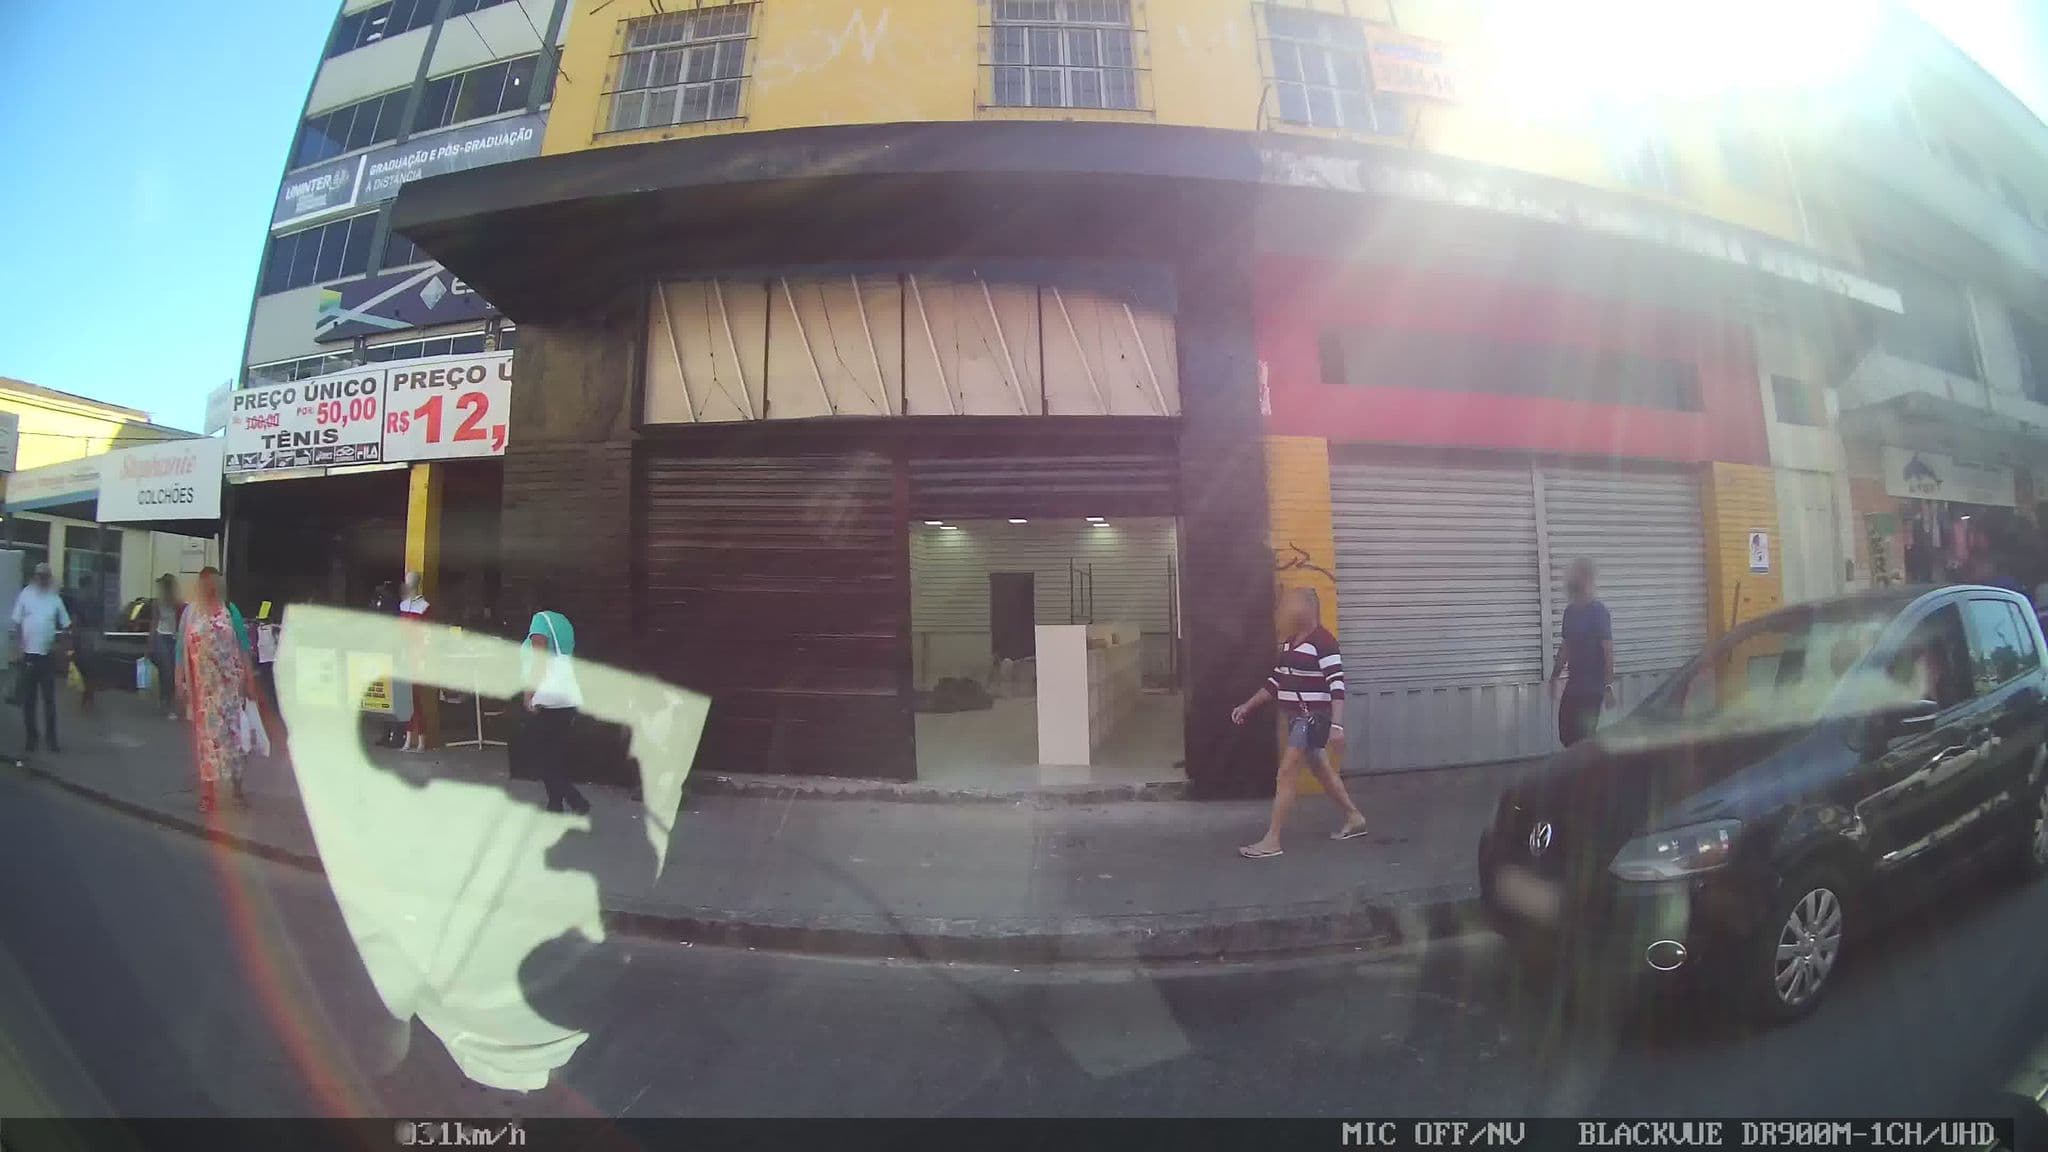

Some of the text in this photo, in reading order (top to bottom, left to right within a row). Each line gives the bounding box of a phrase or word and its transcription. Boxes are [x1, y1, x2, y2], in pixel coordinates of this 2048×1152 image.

[369, 127, 533, 176] GRADUAÇÃO E PÓS-GRADUAÇÃO
[285, 173, 333, 200] UNINTER
[393, 364, 487, 391] PREÇO
[233, 377, 377, 411] PREÇO ÚNICO
[316, 396, 377, 427] 50,00
[261, 428, 339, 450] TÊNIS
[137, 482, 194, 505] COLCHÕES
